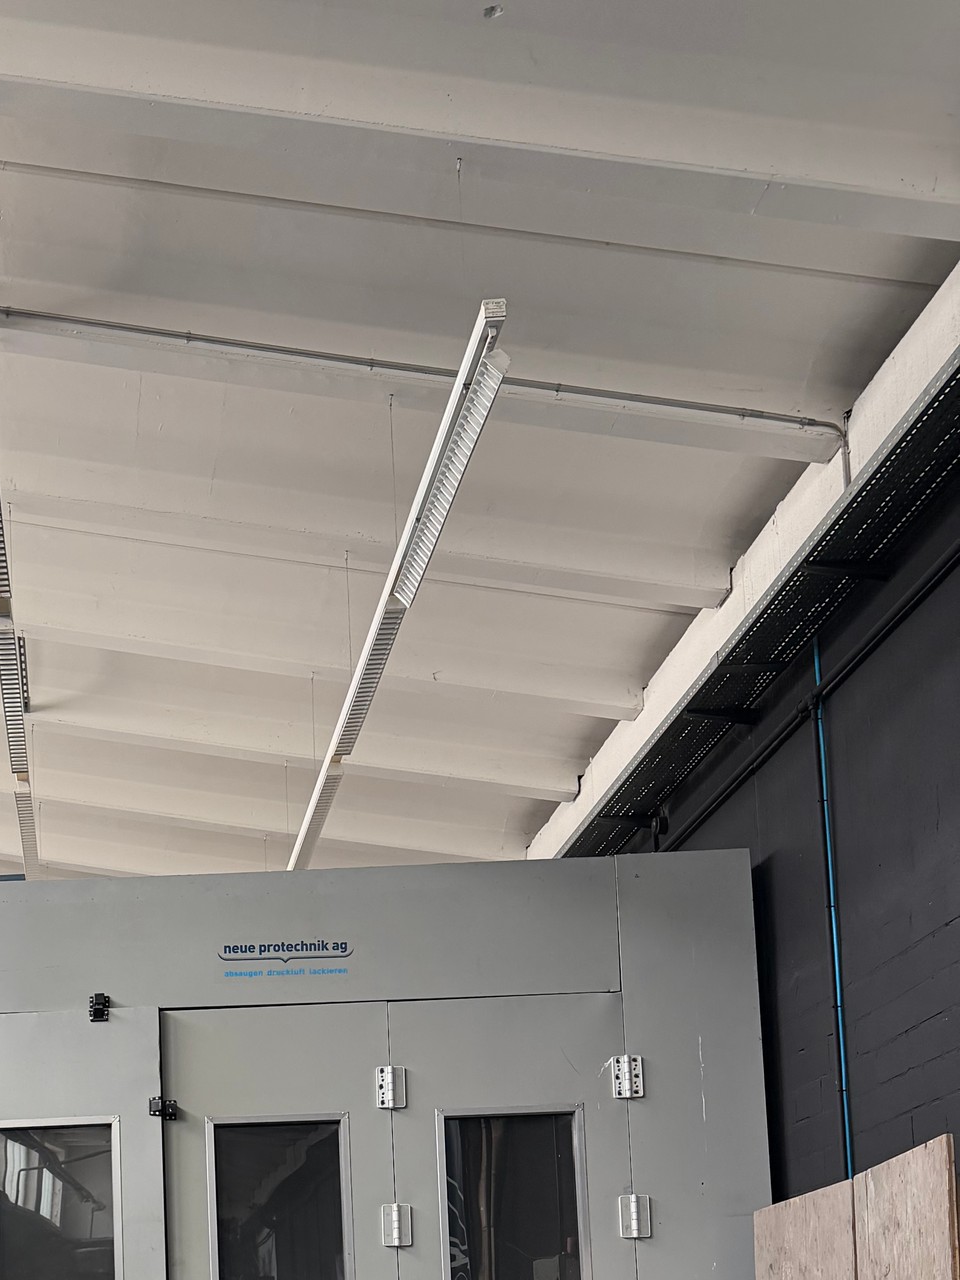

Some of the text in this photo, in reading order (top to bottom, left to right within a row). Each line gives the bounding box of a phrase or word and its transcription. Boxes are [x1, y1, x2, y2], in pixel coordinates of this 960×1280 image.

[223, 940, 348, 955] neue protechnik ag
